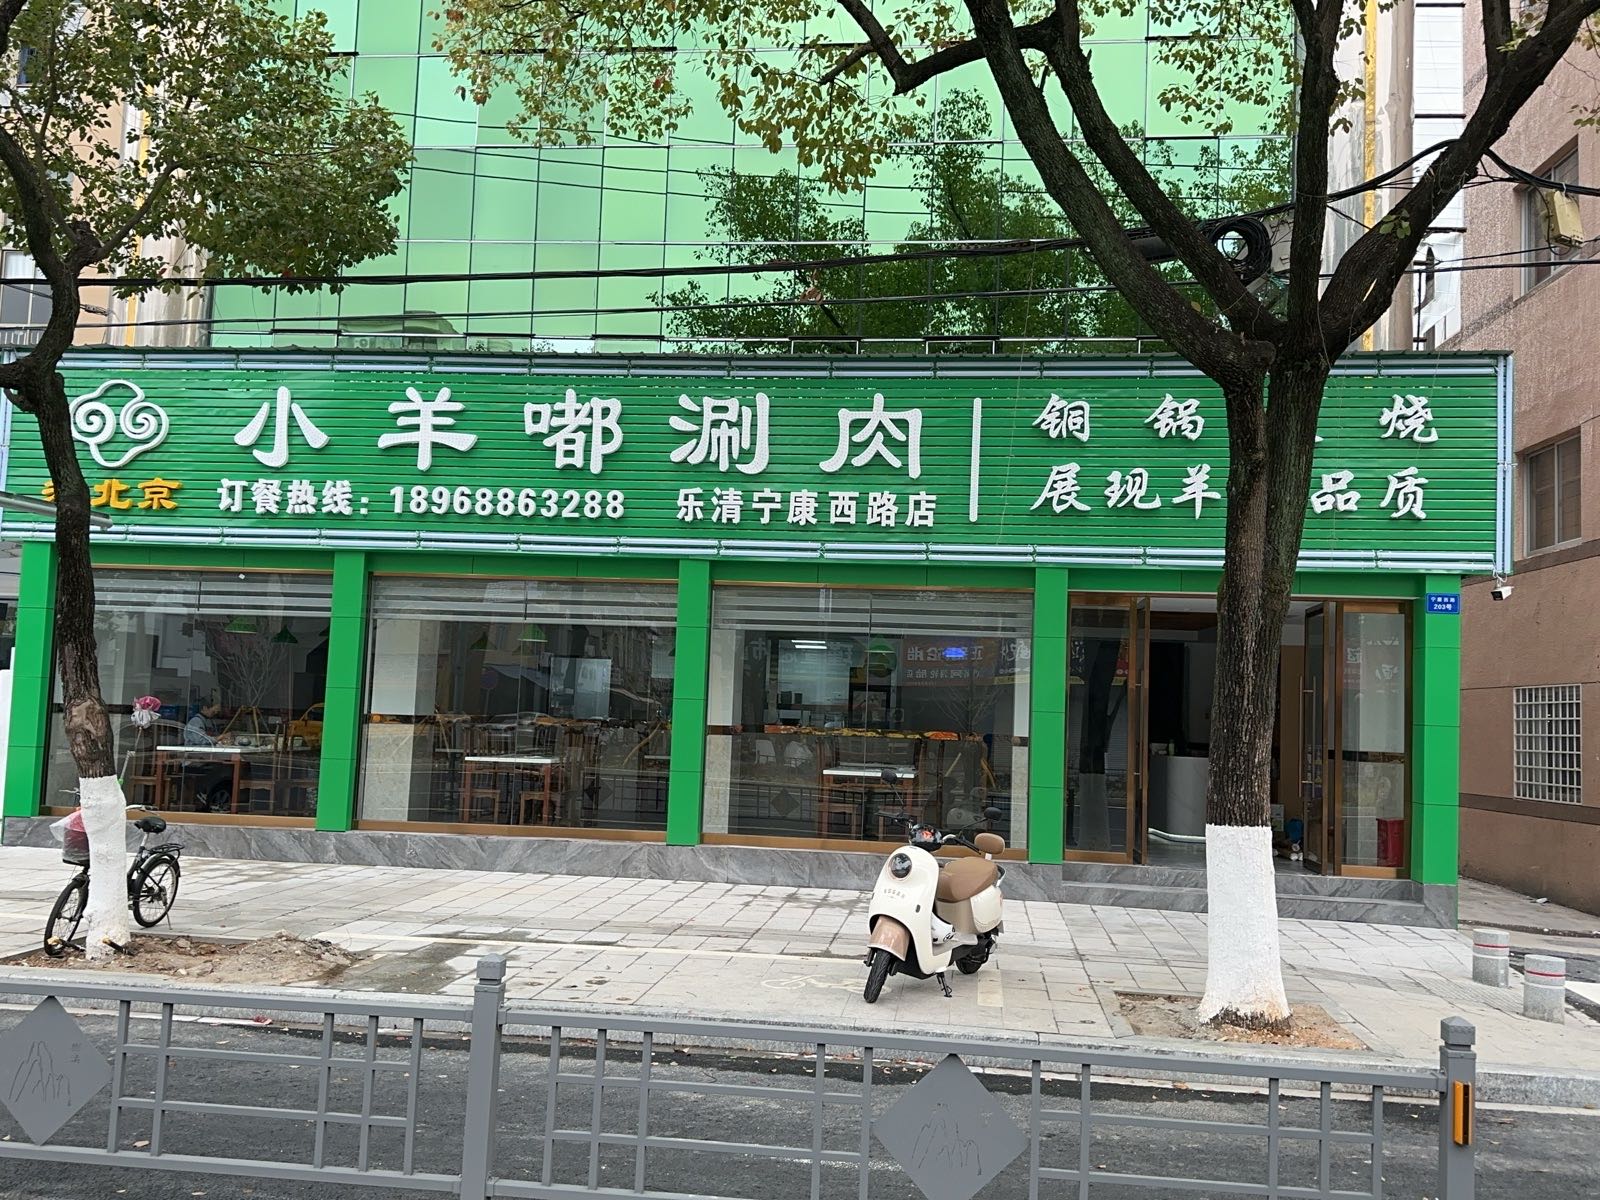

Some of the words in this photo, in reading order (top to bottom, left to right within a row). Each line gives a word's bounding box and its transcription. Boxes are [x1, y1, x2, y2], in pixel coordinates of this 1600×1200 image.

[234, 386, 923, 480] 小羊嘟涮肉
[42, 478, 182, 511] 北京
[676, 487, 937, 528] 乐清宁康西路店
[1030, 462, 1429, 520] 展现羊品质
[1433, 603, 1452, 611] 203号
